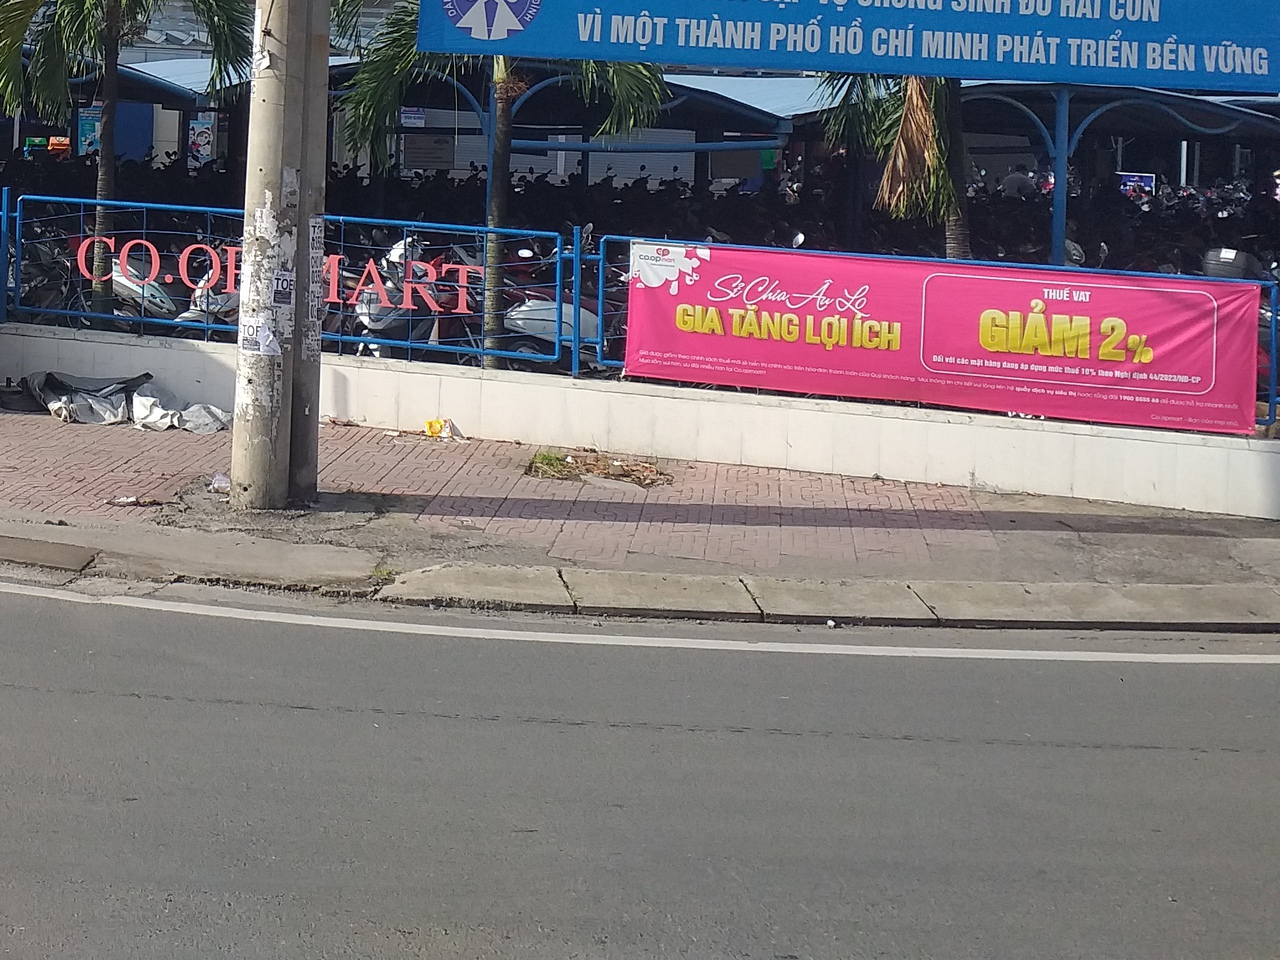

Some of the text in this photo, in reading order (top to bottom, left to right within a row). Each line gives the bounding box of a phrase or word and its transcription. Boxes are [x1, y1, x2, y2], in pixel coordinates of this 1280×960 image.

[577, 8, 1269, 76] VÌ MỘT THÀNH PHỐ HỒ CHÍ MINH PHÁT TRIỂN BỀN VỮNG
[743, 276, 789, 305] Chia
[786, 279, 835, 310] Âu
[835, 285, 871, 317] Lo
[1043, 287, 1091, 302] THUẾ VAT
[676, 304, 901, 351] GIA TĂNG LỢI ÍCH
[979, 298, 1154, 364] GIẢM 2%
